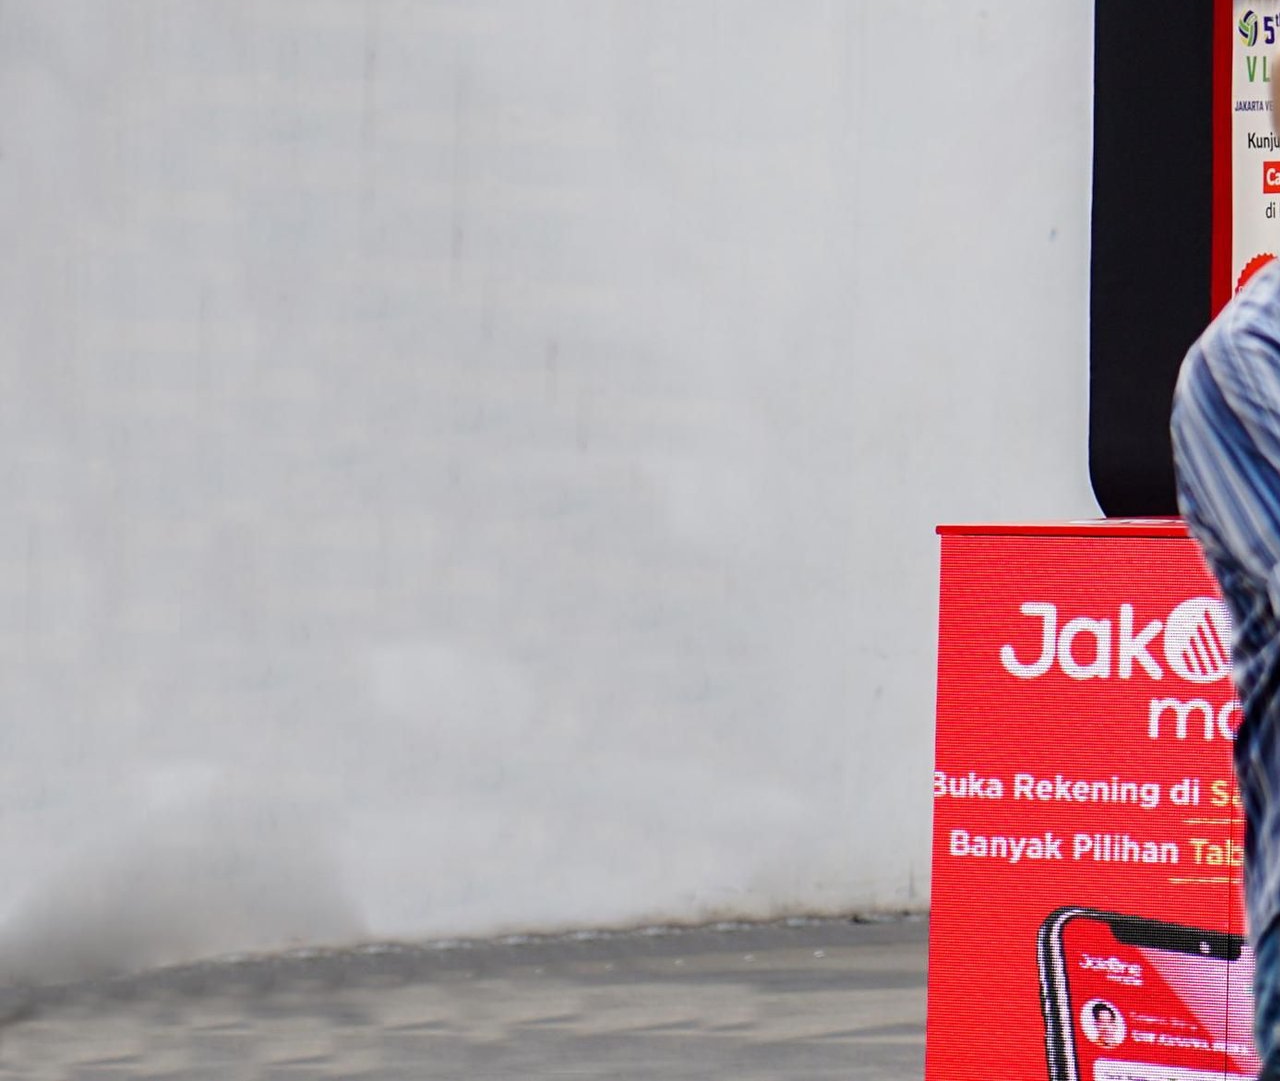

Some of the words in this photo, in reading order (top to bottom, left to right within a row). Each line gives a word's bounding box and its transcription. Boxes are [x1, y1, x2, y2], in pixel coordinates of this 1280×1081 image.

[1246, 55, 1257, 82] V
[1235, 101, 1264, 112] JAKARTA
[1265, 201, 1276, 218] di
[1001, 596, 1233, 684] JakO
[1147, 696, 1245, 740] mo
[934, 771, 1003, 798] Buka
[1013, 773, 1161, 809] Rekening
[1169, 778, 1199, 806] di
[1210, 780, 1243, 807] Sa
[949, 828, 1063, 863] Banyak
[1072, 833, 1179, 864] Pilihan
[1188, 838, 1245, 866] Tab
